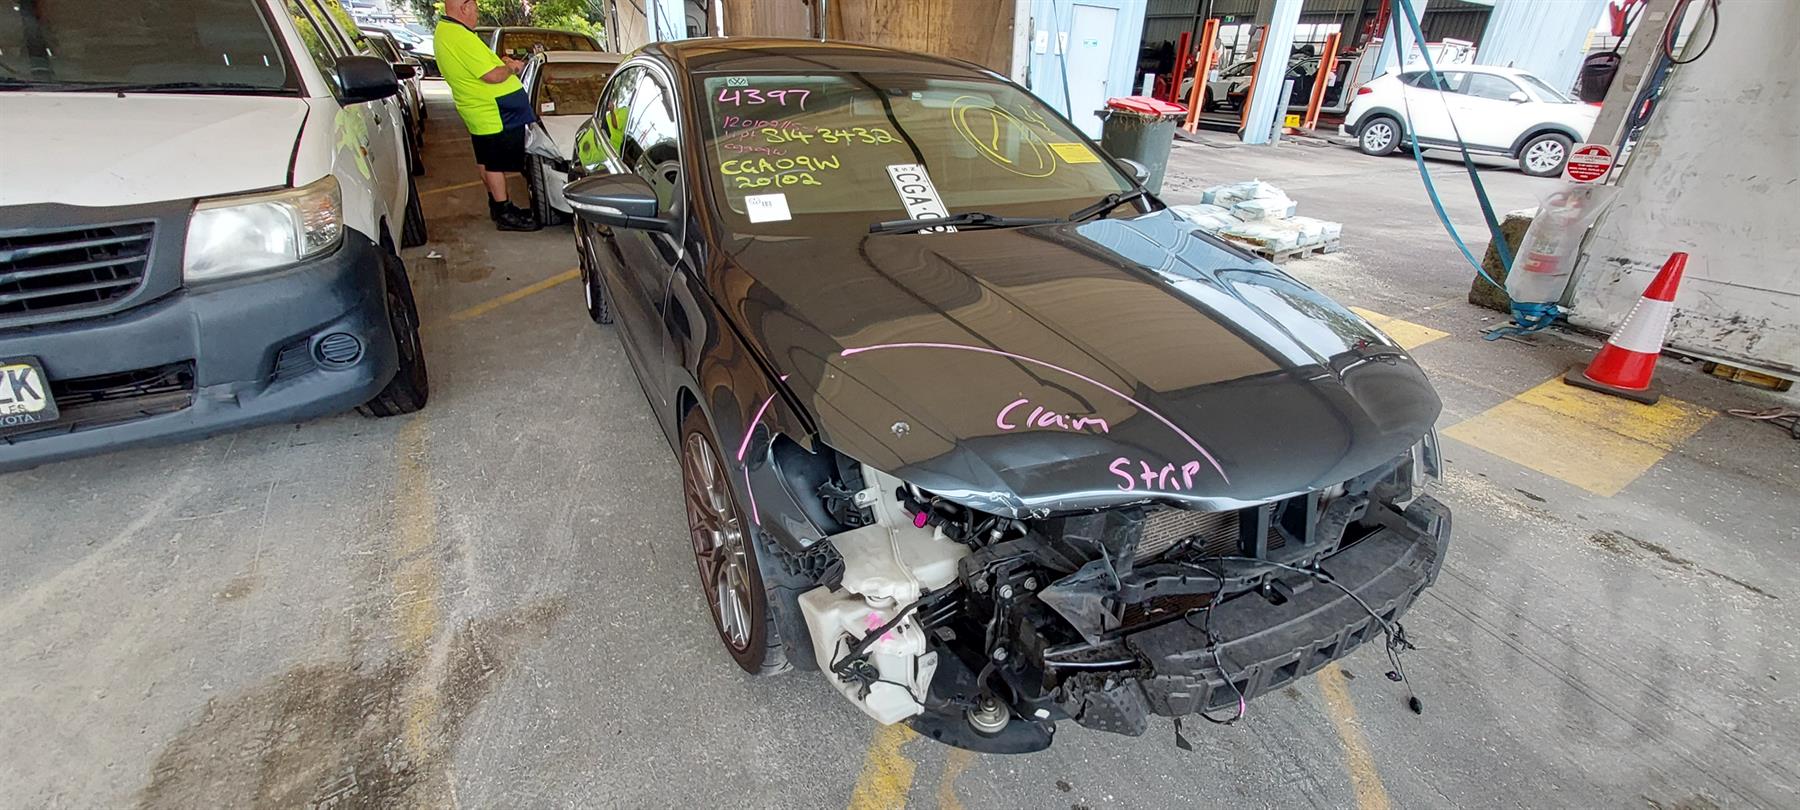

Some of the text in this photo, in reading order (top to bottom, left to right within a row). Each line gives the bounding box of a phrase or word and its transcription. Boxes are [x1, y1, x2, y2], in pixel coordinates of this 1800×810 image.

[718, 88, 810, 111] 4397
[720, 155, 840, 175] CGA09W
[996, 399, 1109, 433] Claim
